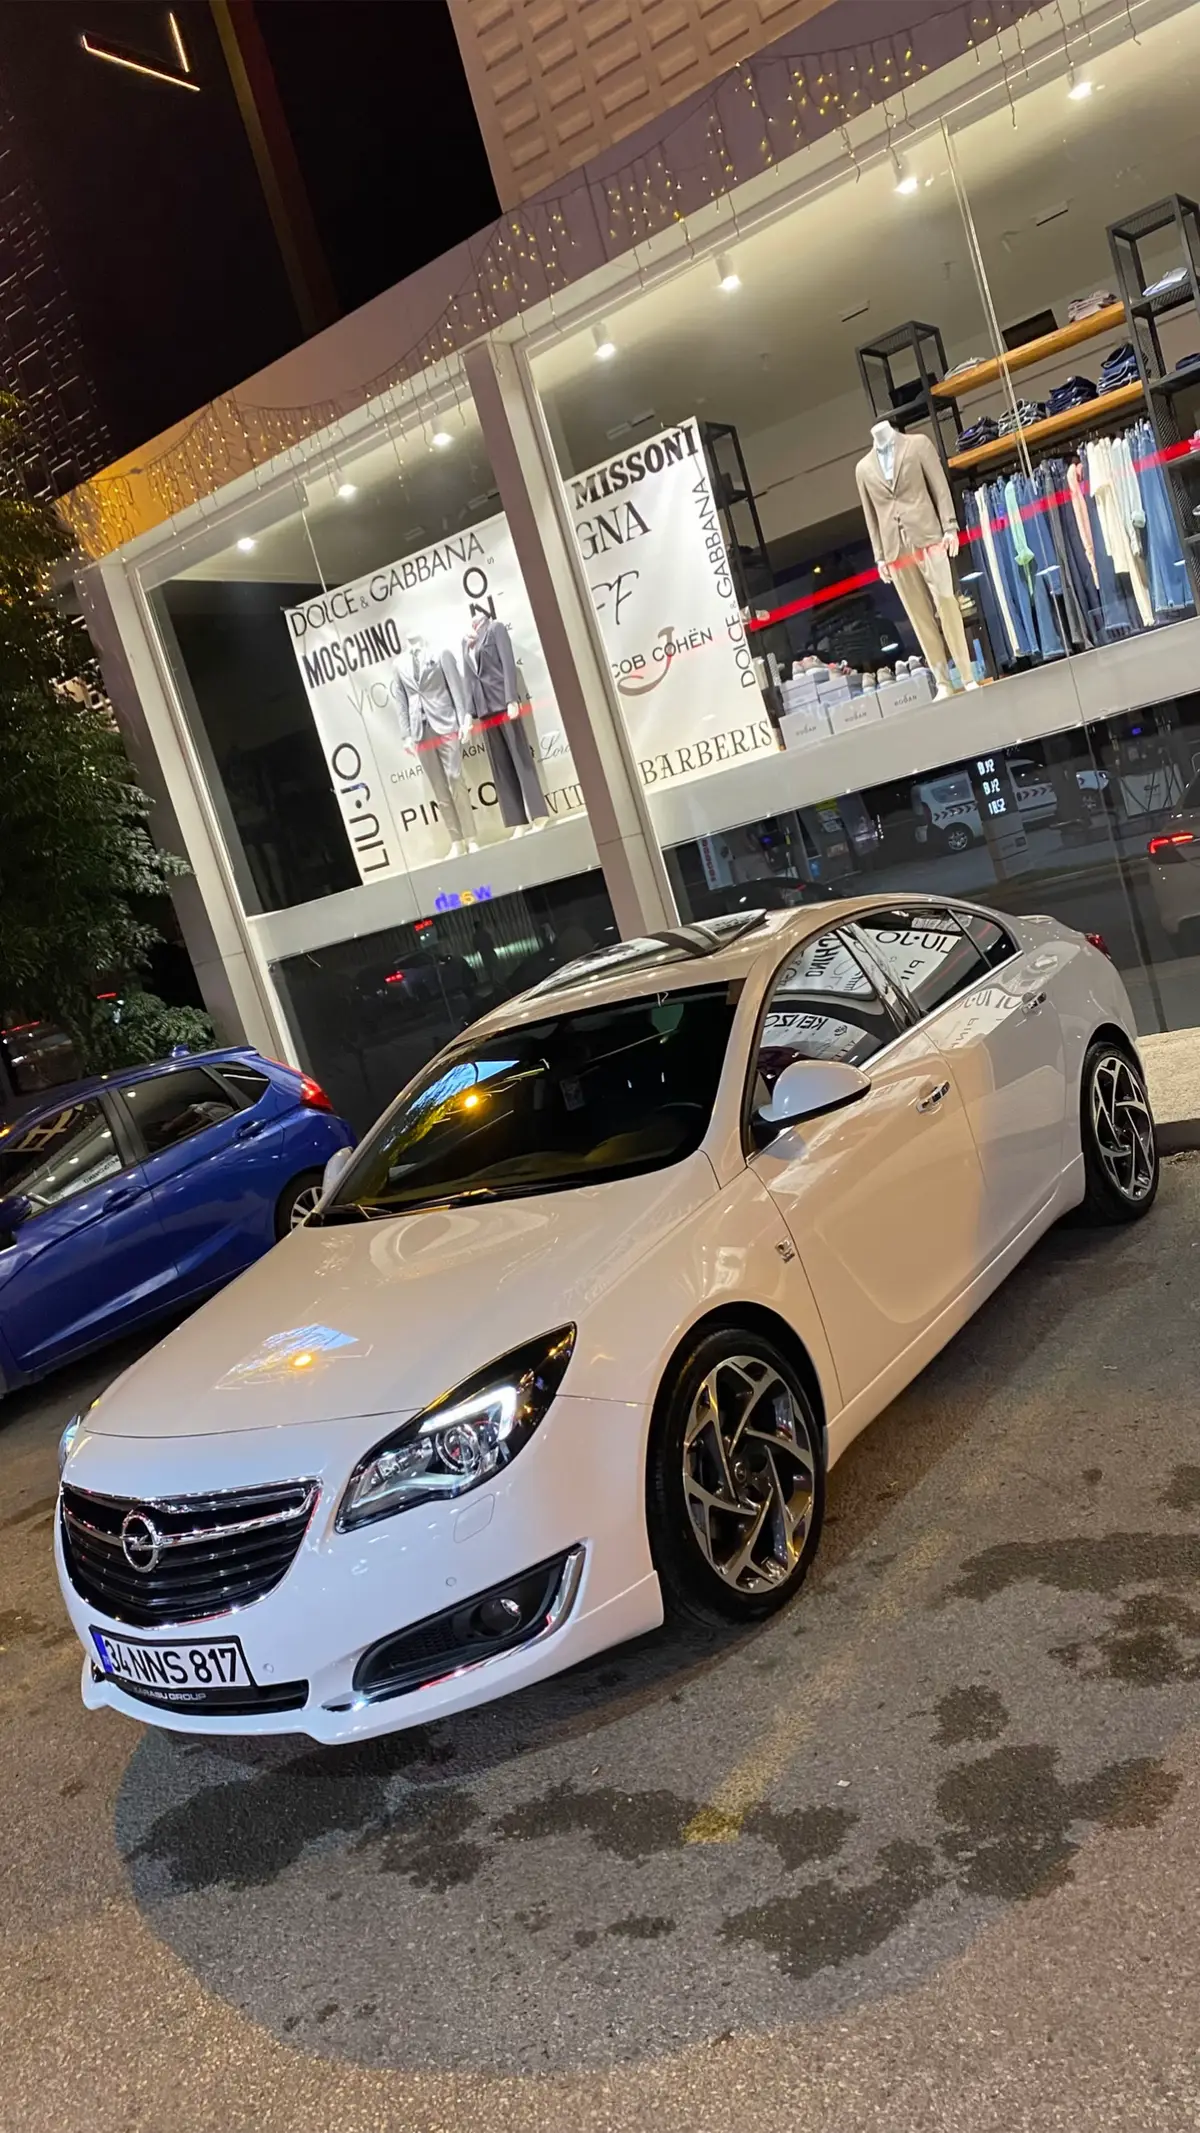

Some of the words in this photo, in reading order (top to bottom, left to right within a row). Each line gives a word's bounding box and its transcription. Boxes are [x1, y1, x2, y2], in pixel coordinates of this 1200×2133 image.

[571, 425, 699, 510] MISSONI
[692, 477, 733, 598] GABBANA
[290, 589, 358, 637] DOLCE
[369, 532, 485, 601] GABBANA
[302, 618, 401, 688] MOSCHINO
[725, 614, 756, 688] DOLCE
[638, 720, 772, 785] BARBERIS
[105, 1640, 132, 1677] 34
[128, 1647, 188, 1684] NNS
[189, 1647, 237, 1683] 817
[168, 1693, 206, 1701] GROUP
